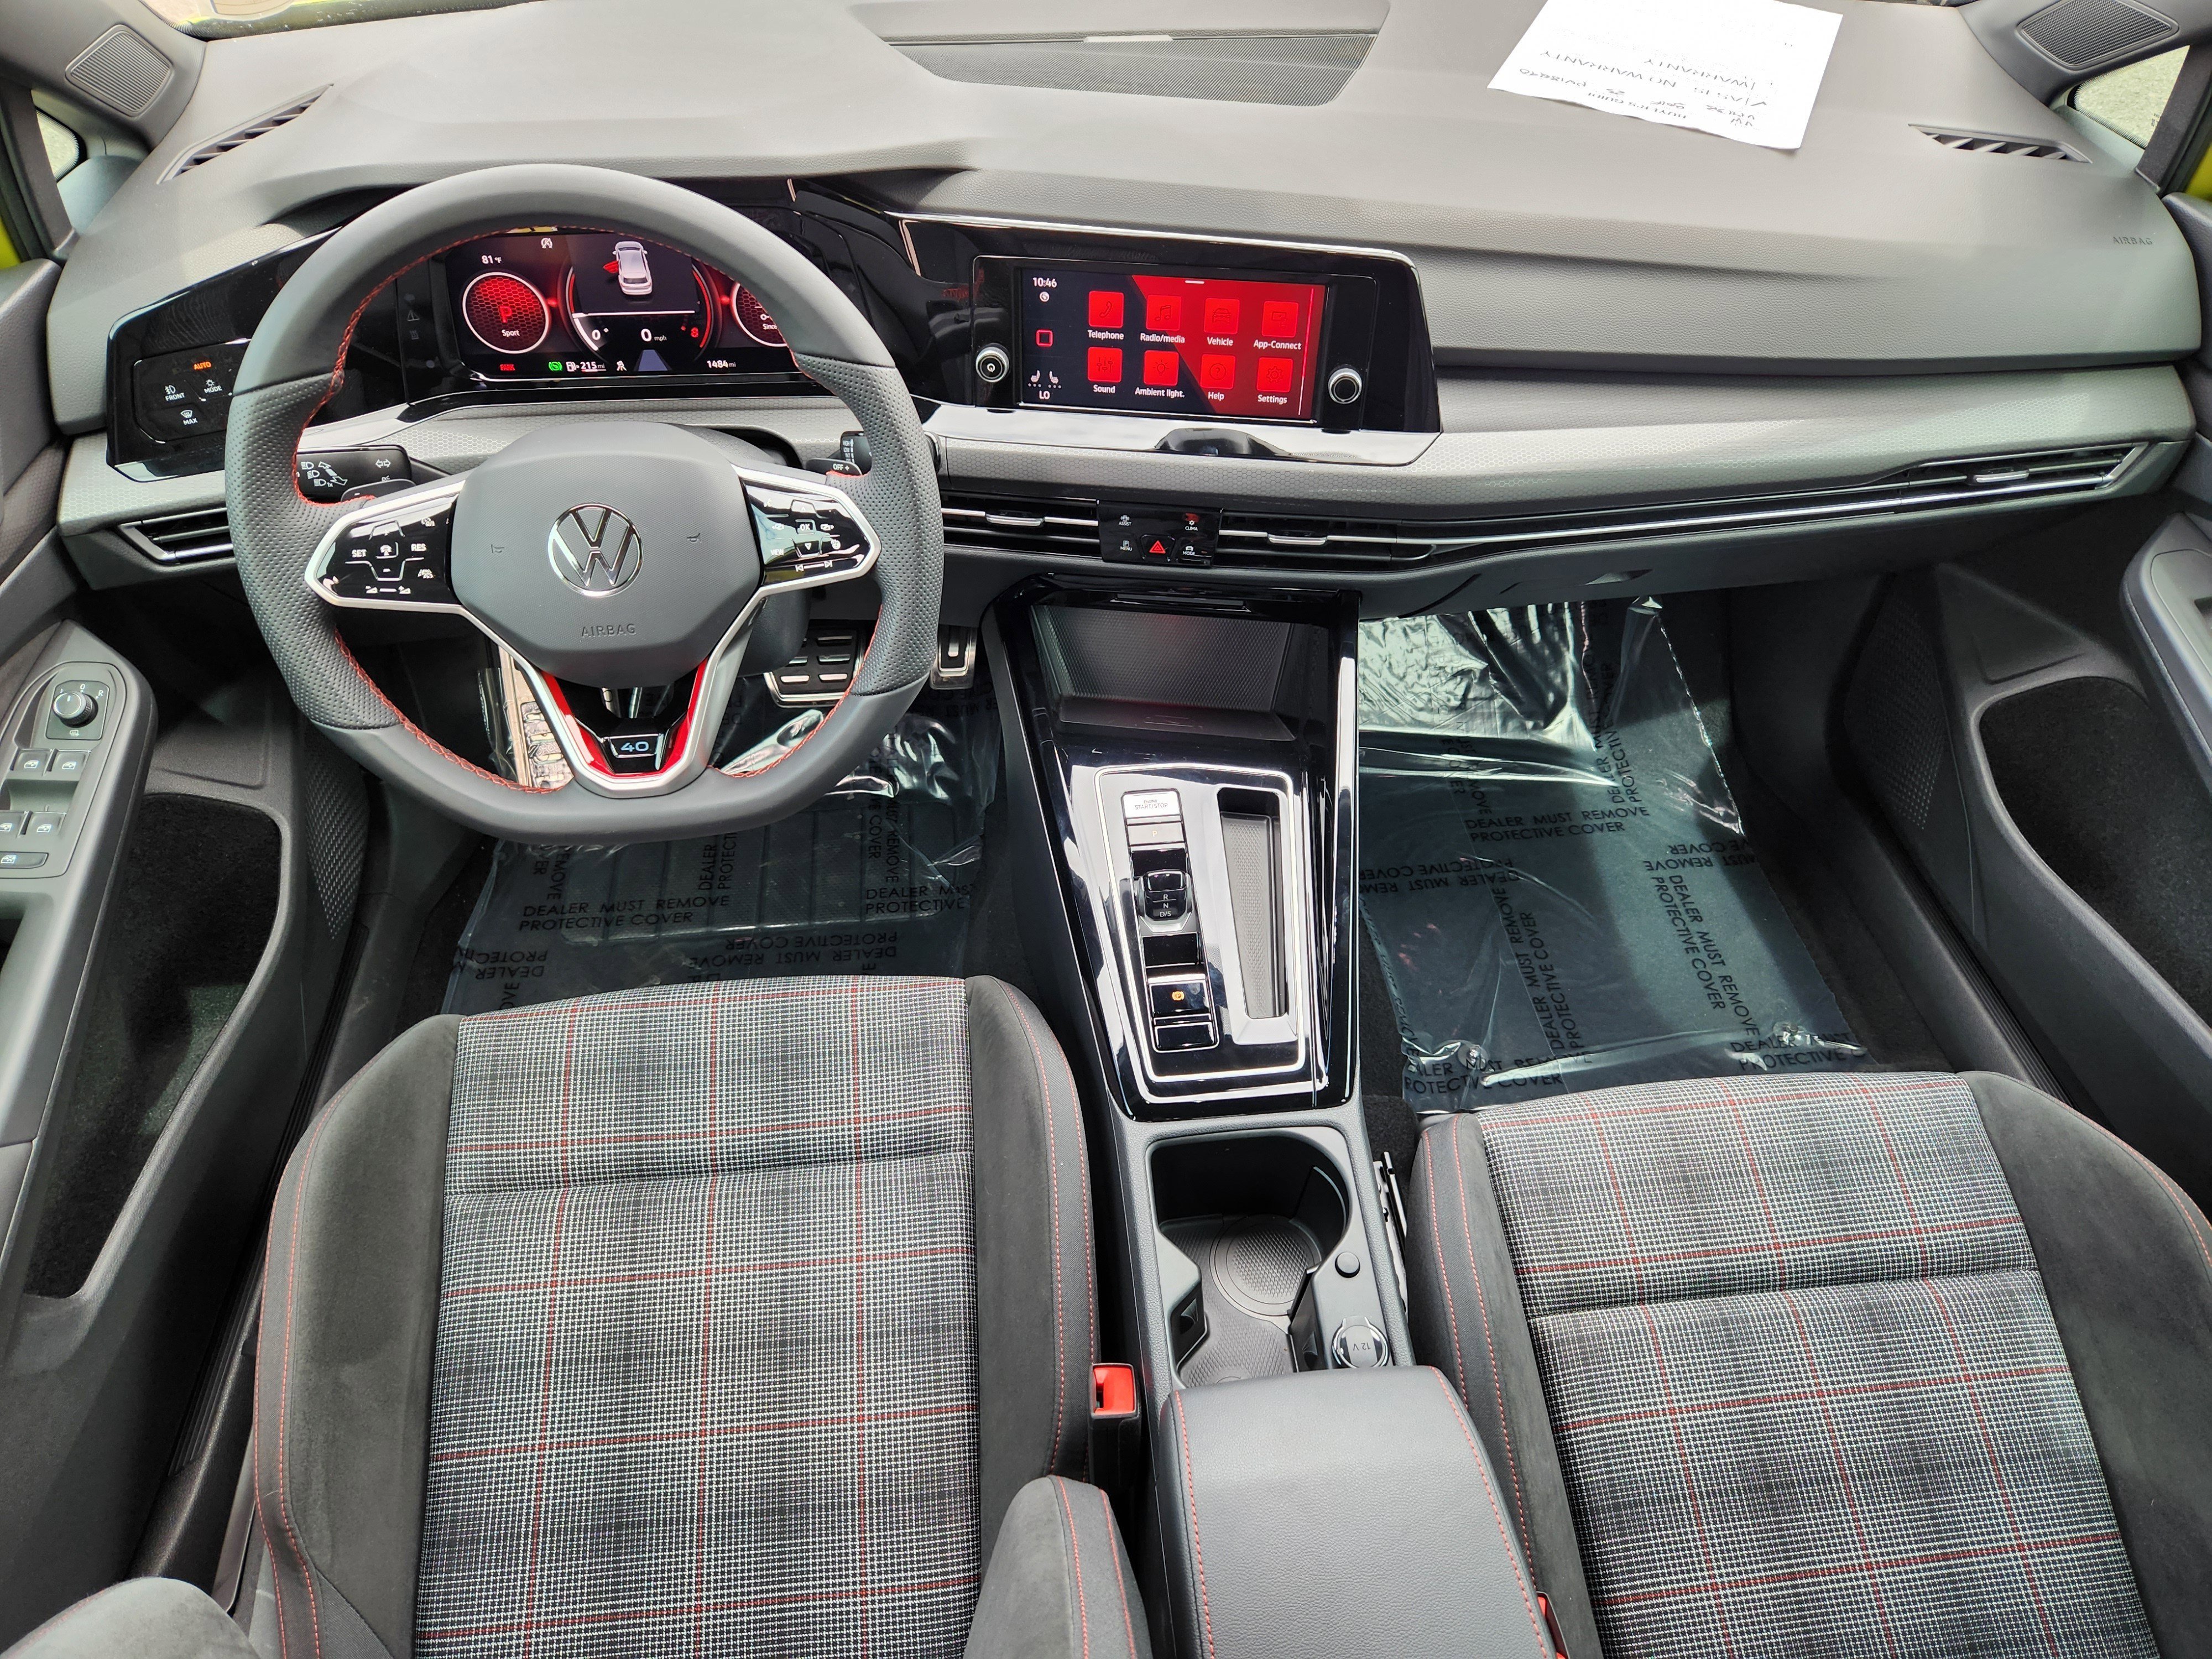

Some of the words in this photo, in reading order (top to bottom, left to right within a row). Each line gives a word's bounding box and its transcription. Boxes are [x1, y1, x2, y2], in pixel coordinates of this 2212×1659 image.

[1649, 76, 1677, 88] NO
[2112, 236, 2153, 246] AIRBAG
[1032, 277, 1057, 288] 10:46
[499, 305, 513, 323] P
[502, 329, 520, 338] Sport
[592, 330, 601, 341] 0
[641, 328, 652, 342] 0
[1087, 330, 1124, 341] Telephone
[1140, 333, 1185, 344] Radio/media
[1207, 336, 1233, 346] Vehicle
[1253, 340, 1302, 351] App-Connect
[194, 361, 211, 369] AUTO
[581, 361, 597, 369] 215
[707, 360, 729, 368] 1484
[204, 385, 222, 393] MODE
[1039, 390, 1050, 400] LO
[1093, 384, 1116, 393] Sound
[1135, 387, 1165, 396] Ambient
[1166, 388, 1185, 399] light.
[165, 393, 185, 401] FRONT
[1208, 392, 1225, 401] Help
[1258, 394, 1288, 405] Settings
[411, 544, 426, 552] RES
[581, 623, 637, 638] AIRBAG
[1588, 708, 1604, 749] MUST
[620, 741, 649, 753] 40
[1603, 722, 1642, 803] PROTECTIVE
[1597, 757, 1625, 804] DEALER
[1465, 816, 1524, 828] DEALER
[1533, 812, 1573, 825] MUST
[1582, 807, 1650, 820] REMOVE
[867, 816, 882, 859] COVER
[1470, 827, 1564, 842] PROTECTIVE
[1569, 822, 1625, 836] COVER
[1668, 842, 1726, 854] COVER
[717, 832, 739, 890] PROTECTI
[885, 829, 900, 883] REMOVE
[698, 844, 717, 890] DEALER
[1421, 859, 1514, 873] PROTECTIVE
[1643, 856, 1713, 871] REMOVE
[1409, 878, 1448, 891] MUST
[1460, 870, 1520, 886] DEALER
[866, 886, 928, 900] DEALER
[523, 902, 589, 917] DEALER
[600, 900, 646, 914] MUST
[656, 895, 730, 909] REMOVE
[865, 897, 964, 914] PROTECTIVE
[519, 917, 624, 931] PROTECTIVE
[630, 912, 693, 926] COVER
[1493, 888, 1523, 943] REMOVE
[725, 937, 788, 950] COVER
[795, 931, 898, 947] PROTECTIVE
[1520, 912, 1548, 961] COVER
[1651, 877, 1699, 954] PROTECTIVE
[1692, 957, 1725, 1009] COVER
[688, 953, 764, 969] REMOVE
[776, 951, 820, 963] MUST
[832, 946, 897, 962] DEALER
[1670, 875, 1703, 922] DEALER
[1697, 930, 1726, 966] MUST
[1718, 975, 1760, 1036] REMOVE
[475, 966, 545, 980] DEALER
[1516, 952, 1541, 987] MUST
[1540, 963, 1584, 1048] PROTECTIVE
[1532, 997, 1564, 1050] DEALER
[1466, 1057, 1502, 1071] MUST
[1738, 1050, 1846, 1070] PROTECTIVE
[1405, 1075, 1492, 1094] ROTECTIVE
[1498, 1074, 1563, 1088] COVER
[1360, 1342, 1371, 1351] 12
